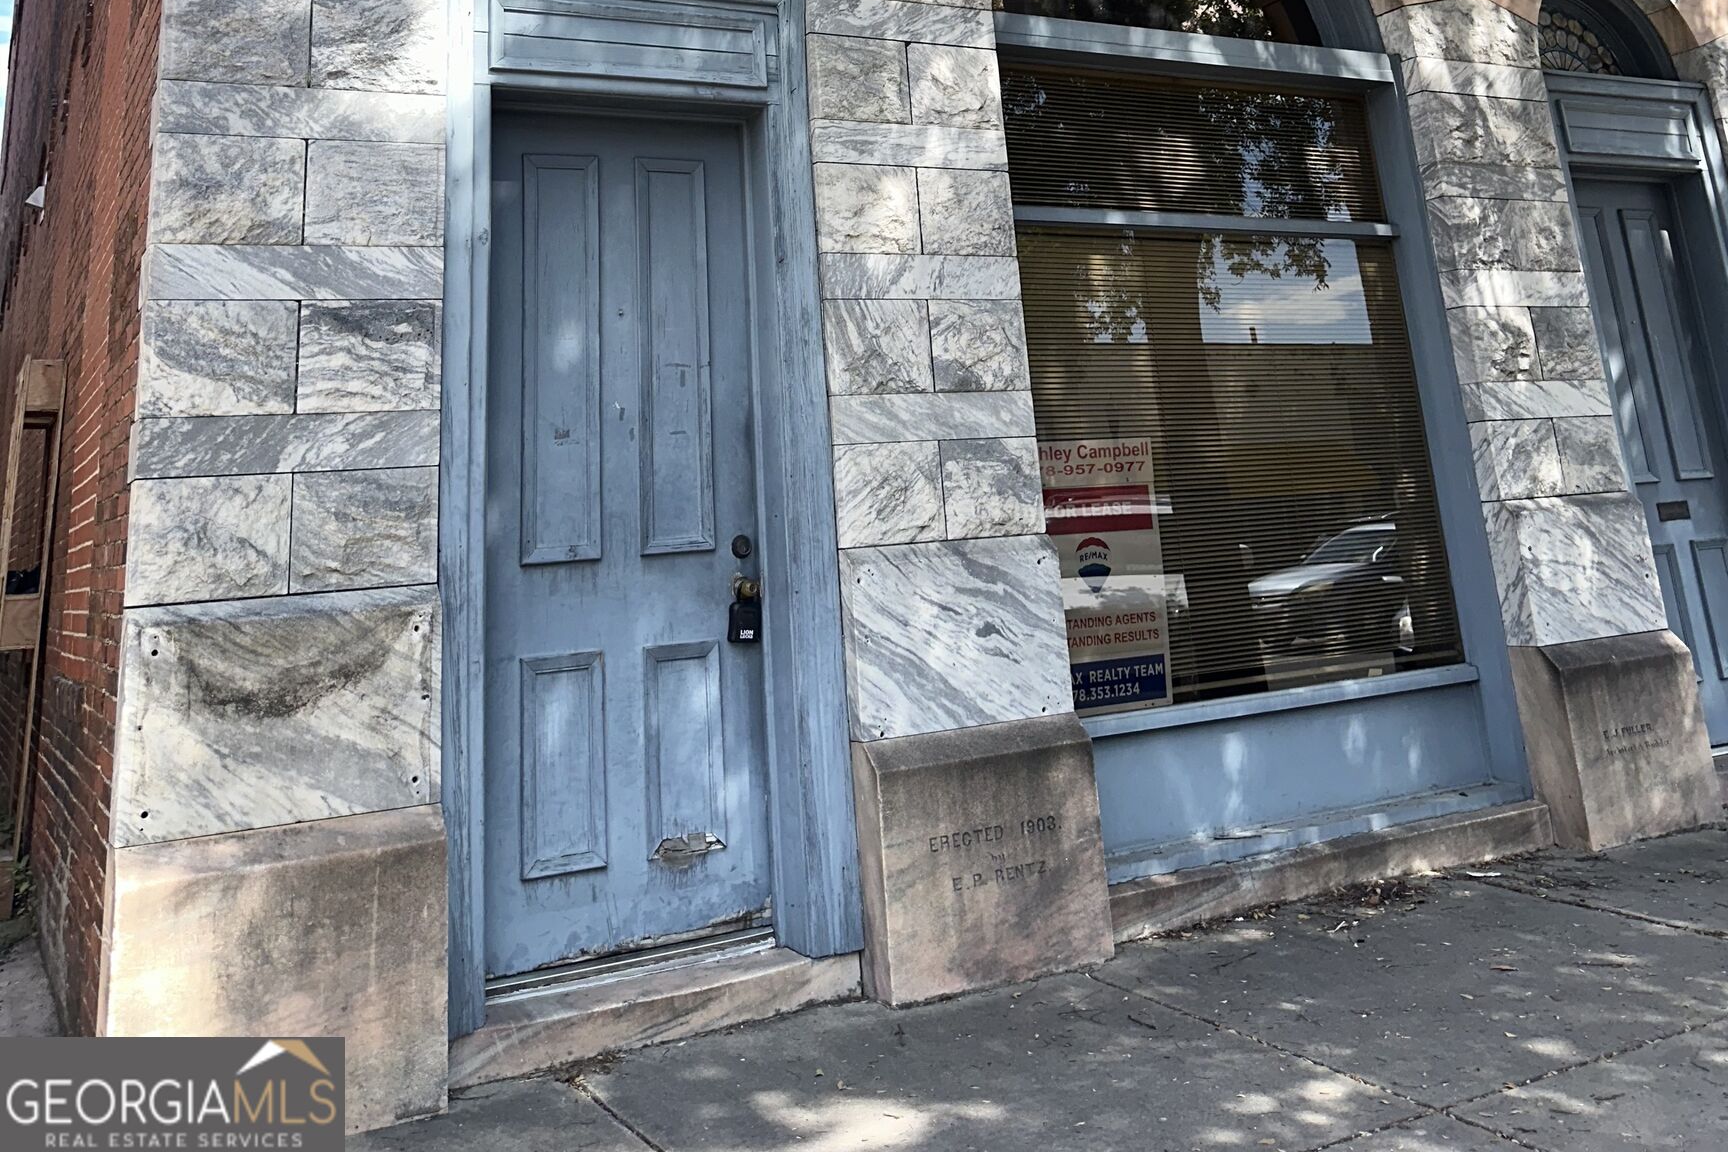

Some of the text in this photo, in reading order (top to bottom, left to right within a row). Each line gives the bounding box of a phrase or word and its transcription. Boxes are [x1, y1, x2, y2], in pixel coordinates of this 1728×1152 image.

[1077, 441, 1149, 461] Campbell
[1040, 460, 1145, 477] 8-957-0977
[1081, 501, 1132, 517] LEASE
[1079, 551, 1108, 562] RE/MAX
[1115, 611, 1156, 624] AGENTS
[1114, 628, 1160, 644] RESULTS
[1089, 666, 1131, 684] REALTY
[1134, 662, 1164, 677] TEAM
[929, 825, 1004, 853] ERECTED
